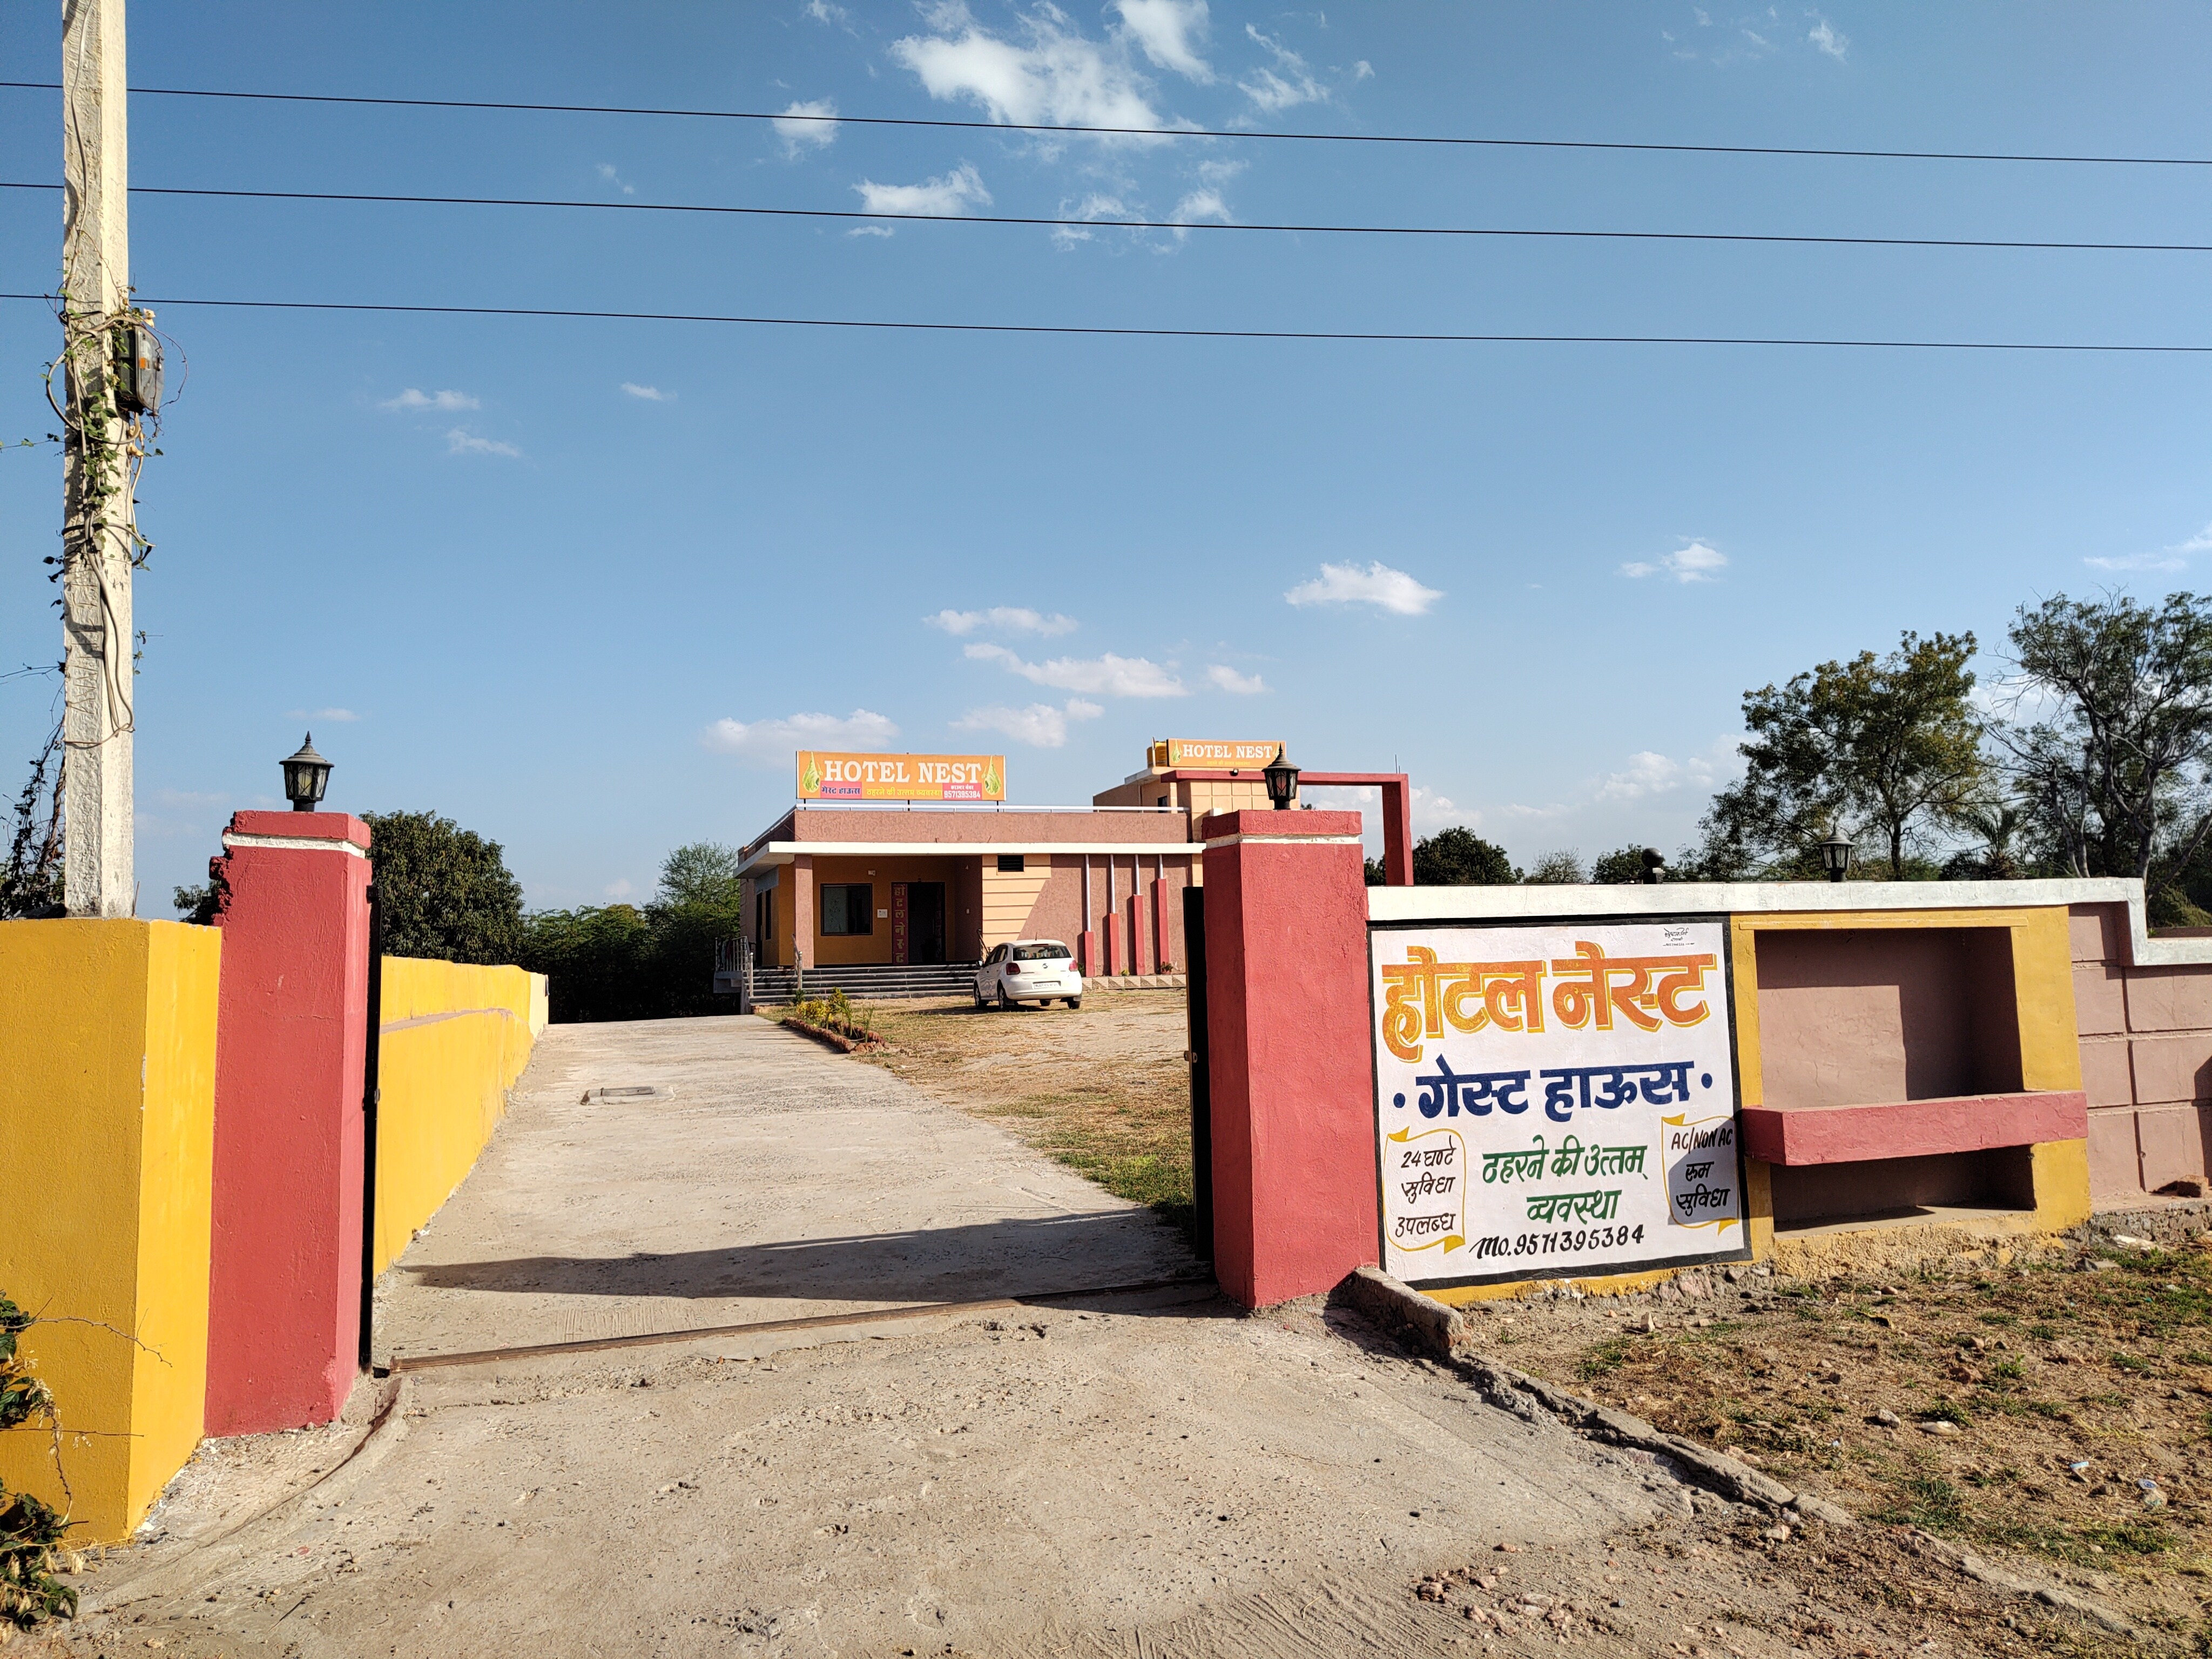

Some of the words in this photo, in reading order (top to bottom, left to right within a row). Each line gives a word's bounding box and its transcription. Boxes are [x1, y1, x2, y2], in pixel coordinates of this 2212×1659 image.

[1183, 744, 1232, 758] HOTEL
[1236, 745, 1273, 759] NEST
[824, 759, 911, 783] HOTEL
[918, 762, 982, 784] NEST
[887, 787, 895, 795] की
[944, 790, 981, 798] 9571395384
[1381, 946, 1547, 1063] होटल
[1552, 941, 1718, 1033] नेस्ट
[1415, 1053, 1531, 1119] गेस्ट
[1540, 1061, 1695, 1122] हाऊस
[1671, 1127, 1718, 1154] AC/NON
[1718, 1128, 1732, 1147] AC
[1401, 1150, 1421, 1168] 24
[1482, 1135, 1550, 1184] ठहरने
[1550, 1135, 1586, 1177] की
[1401, 1171, 1456, 1204] सुविधा
[1676, 1183, 1731, 1216] सुविधा
[1526, 1190, 1622, 1225] व्यवस्था
[1395, 1212, 1456, 1238] उपलब्ध
